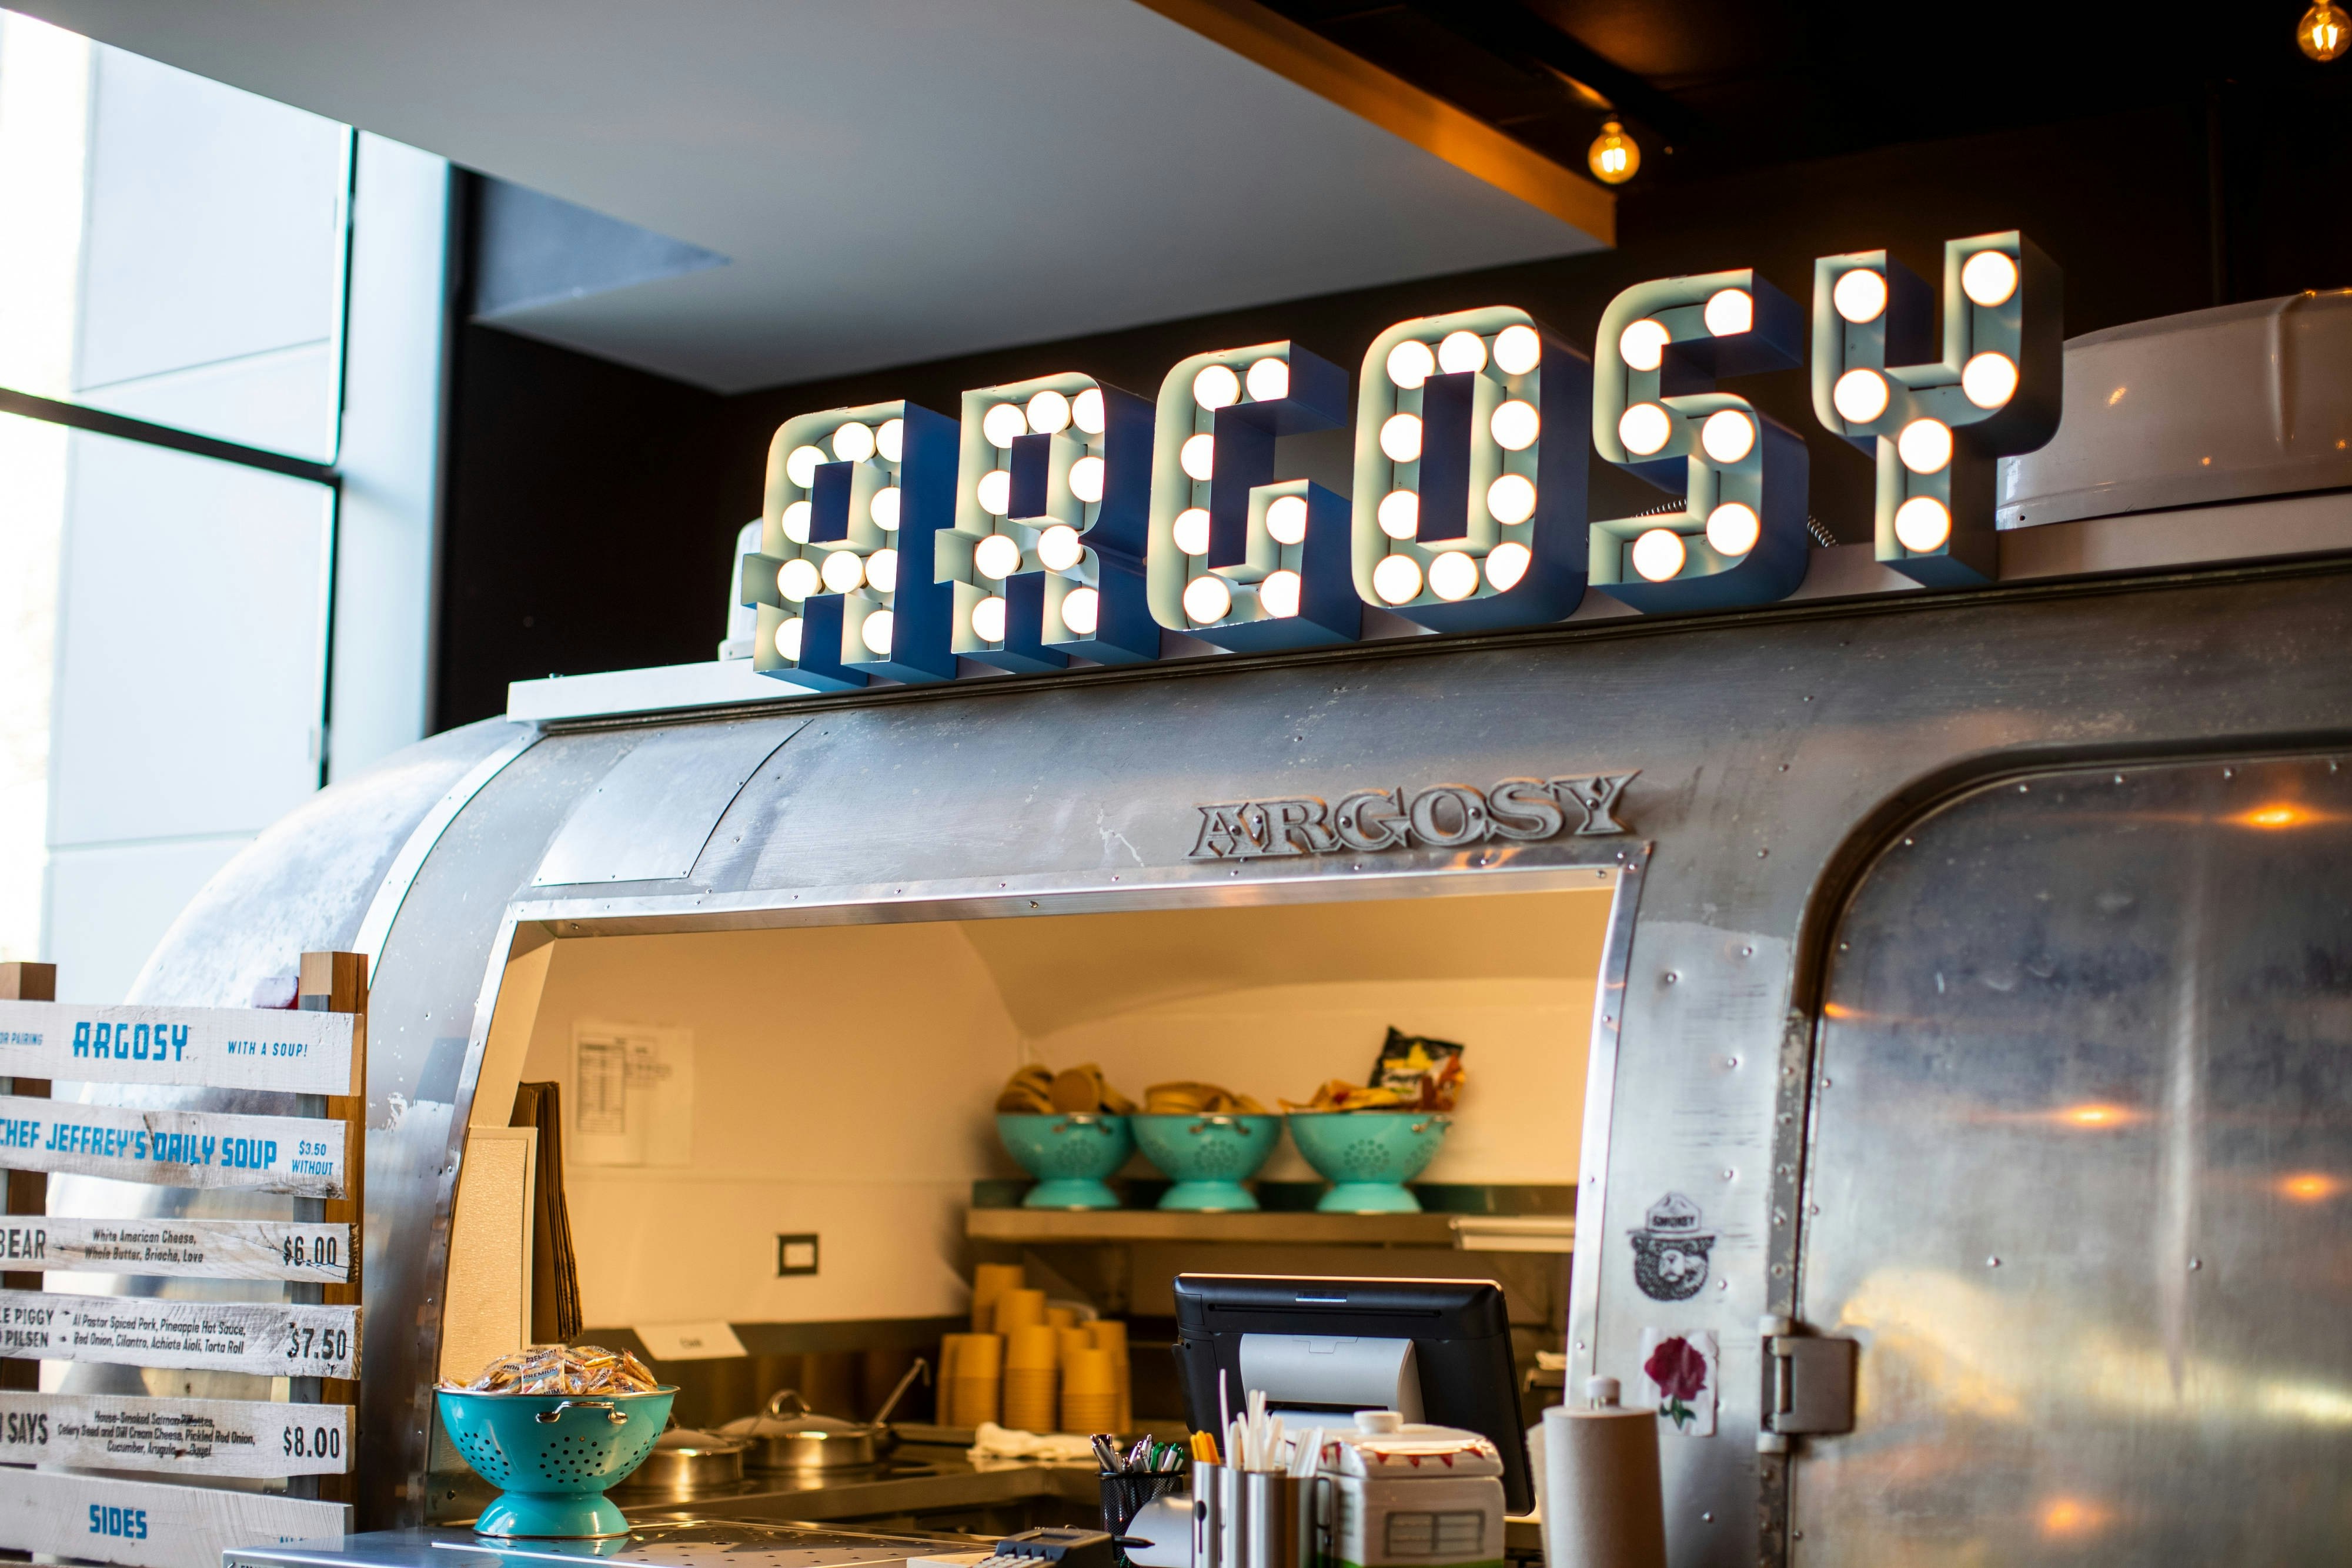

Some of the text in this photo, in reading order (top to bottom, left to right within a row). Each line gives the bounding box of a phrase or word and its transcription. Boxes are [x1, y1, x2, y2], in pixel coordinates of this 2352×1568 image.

[741, 230, 2063, 693] ARGOSY
[1181, 768, 1643, 861] ARGOSY
[11, 1032, 44, 1046] PAIRING
[73, 1022, 188, 1061] ARGOSY
[228, 1041, 256, 1055] WITH
[261, 1042, 266, 1055] A
[272, 1042, 308, 1057] SOUP!
[46, 1123, 146, 1159] JEFFREY'S
[153, 1132, 215, 1165] DAILY
[221, 1137, 277, 1169] SOUP
[299, 1140, 327, 1156] $3.50
[292, 1159, 334, 1176] WITHOUT
[92, 1228, 196, 1246] White American Cheese,
[85, 1246, 203, 1264] Whole Butter, Brioche, Love
[283, 1236, 337, 1266] $6.00
[0, 1308, 54, 1326] E PIGGY
[73, 1314, 246, 1338] Al Pastor Spiced Pork, Pineapple Hot Sauce,
[5, 1330, 49, 1348] PILSEN
[74, 1332, 244, 1355] Red Onion, Cilantro, Achiote Aioli, Torta Roll
[287, 1328, 347, 1360] $7.50
[526, 1348, 557, 1363] PREMIUM
[523, 1368, 558, 1379] PREMIUM
[8, 1412, 48, 1445] SAYS
[94, 1410, 150, 1425] House-Smoked
[151, 1413, 180, 1426] Salmon
[58, 1423, 255, 1446] Celery Seed and Dill Cream Cheese, Pickled Red Onion,
[283, 1426, 340, 1459] $8.00
[107, 1439, 145, 1455] Cucumber,
[89, 1505, 147, 1539] SIDES
